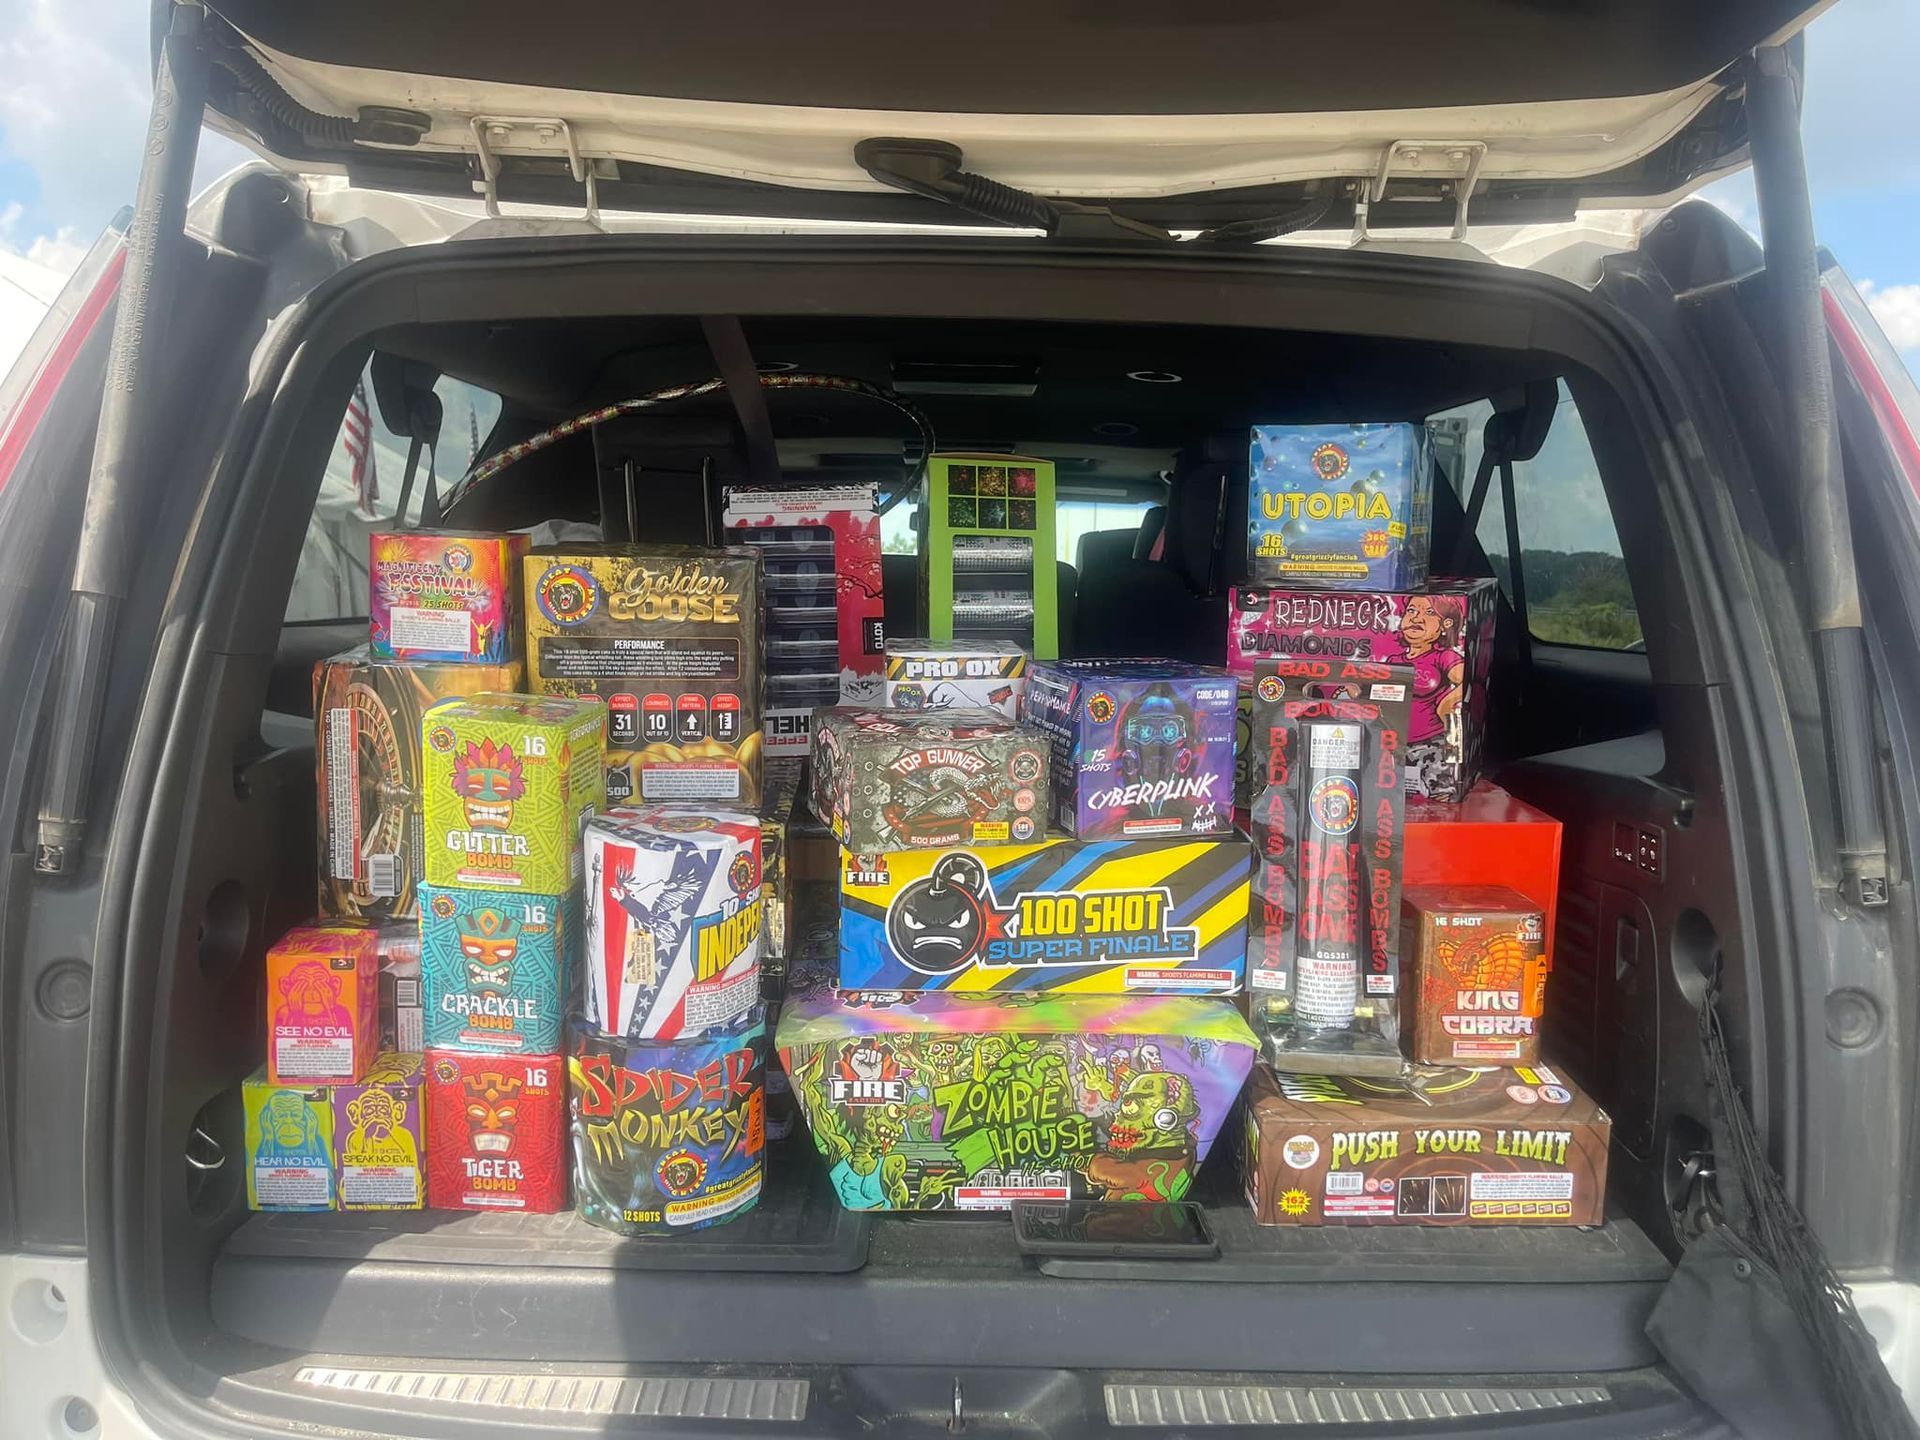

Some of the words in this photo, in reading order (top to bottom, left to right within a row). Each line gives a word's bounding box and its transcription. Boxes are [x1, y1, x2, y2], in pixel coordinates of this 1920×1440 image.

[1262, 492, 1393, 520] UTOPIA
[1261, 534, 1284, 547] 16
[1256, 547, 1287, 557] SHOTS
[388, 573, 478, 597] FESTIVAL
[624, 566, 730, 607] Golden
[436, 600, 464, 609] SHOTS
[609, 591, 741, 624] GOOSE
[1275, 599, 1389, 631] REDNECK
[614, 639, 665, 650] PERFORMANCE
[873, 622, 884, 650] KOTO
[1241, 631, 1372, 658] DIAMONDS
[905, 660, 959, 678] PRO
[966, 660, 1001, 677] OX
[1277, 662, 1331, 679] BAD
[1340, 664, 1392, 679] ASS
[1284, 701, 1379, 719] BOMBS
[615, 713, 632, 730] 31
[648, 714, 666, 730] 10
[523, 735, 546, 756] 16
[1090, 749, 1107, 761] 15
[890, 754, 922, 774] TOP
[927, 749, 986, 773] GUNNER
[1268, 727, 1289, 786] BAD
[1377, 729, 1398, 789] BAD
[1080, 763, 1112, 773] SHOTS
[1088, 772, 1219, 810] CYBERPUNK
[1267, 795, 1286, 855] ASS
[1374, 799, 1393, 859] ASS
[446, 830, 530, 856] GLITTER
[911, 836, 928, 844] 500
[929, 833, 961, 844] GRAMS
[466, 853, 513, 869] BOMB
[847, 871, 889, 884] FIRE
[523, 904, 546, 924] 16
[720, 898, 739, 921] 10
[1019, 898, 1080, 937] 100
[1082, 893, 1163, 934] SHOT
[1435, 917, 1447, 926] 16
[1452, 916, 1483, 926] SHOT
[987, 937, 1082, 961] SUPER
[1089, 932, 1191, 959] FINALE
[1312, 962, 1352, 970] WARNING
[689, 983, 721, 994] WARNING
[441, 993, 538, 1019] CRACKLE
[1456, 990, 1519, 1011] KING
[275, 1026, 302, 1036] SEE
[303, 1026, 323, 1036] NO
[324, 1026, 352, 1036] EVIL
[468, 1013, 514, 1031] BOMB
[1441, 1015, 1533, 1035] COBRA
[525, 1067, 548, 1087] 16
[580, 1048, 755, 1119] SPIDER
[525, 1087, 550, 1096] SHOTS
[834, 1080, 902, 1100] FIRE
[933, 1080, 1059, 1135] ZOMBIE
[587, 1100, 749, 1166] MONKEY
[987, 1117, 1094, 1171] HOUSE
[1331, 1131, 1399, 1170] PUSH
[1414, 1130, 1481, 1154] YOUR
[1495, 1130, 1572, 1165] LIMIT
[254, 1157, 284, 1166] HEAR
[285, 1157, 302, 1166] NO
[303, 1157, 327, 1166] EVIL
[344, 1154, 375, 1163] SPEAK
[376, 1154, 393, 1163] NO
[394, 1155, 414, 1163] EVIL
[461, 1157, 524, 1179] TIGER
[1020, 1161, 1045, 1177] 115
[1050, 1152, 1095, 1170] SHOT
[472, 1177, 518, 1191] BOMB
[672, 1198, 715, 1212] WARNING
[623, 1209, 632, 1221] 12
[633, 1209, 661, 1222] SHOTS
